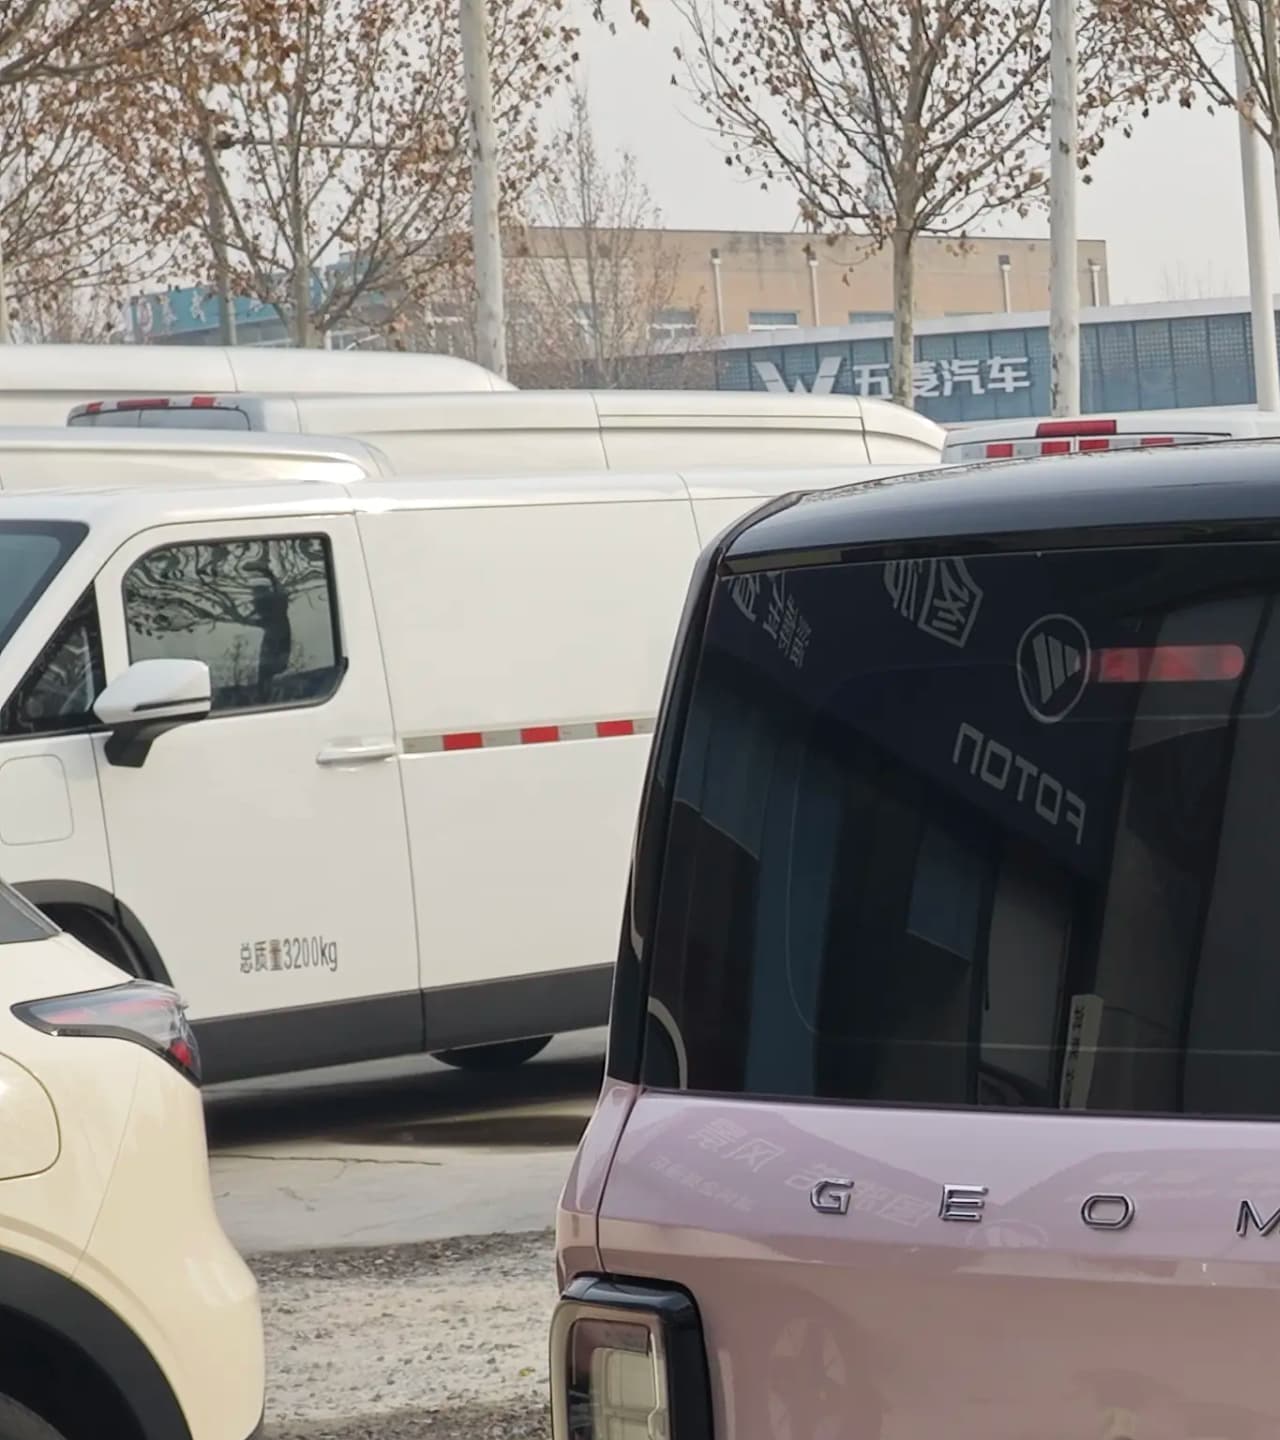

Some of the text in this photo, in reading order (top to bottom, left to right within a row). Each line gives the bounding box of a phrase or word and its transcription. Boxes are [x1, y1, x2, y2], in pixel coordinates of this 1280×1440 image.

[853, 356, 1031, 399] 五菱汽车
[240, 936, 338, 974] 总质量3200kg
